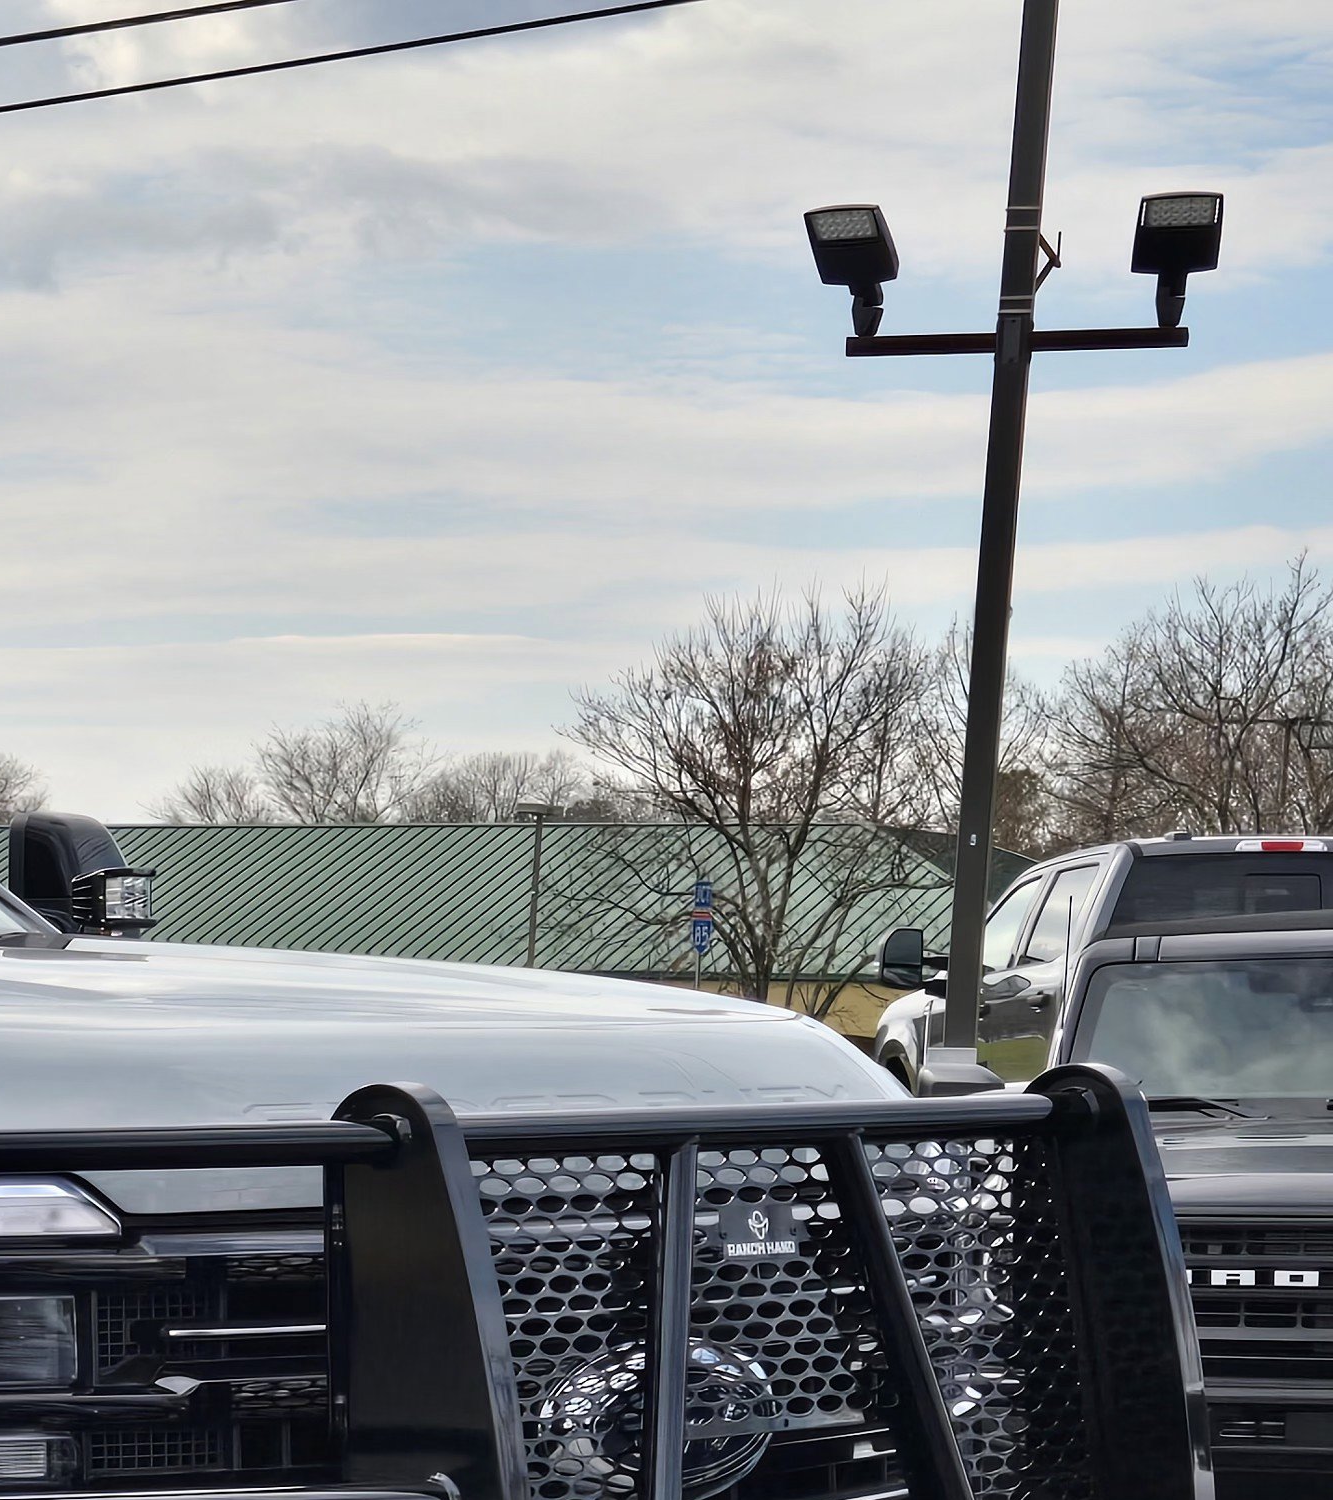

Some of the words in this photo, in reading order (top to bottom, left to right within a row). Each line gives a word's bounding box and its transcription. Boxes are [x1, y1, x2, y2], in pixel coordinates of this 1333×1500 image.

[694, 926, 710, 947] 85
[727, 1242, 766, 1257] RANCH
[766, 1240, 796, 1254] HAND
